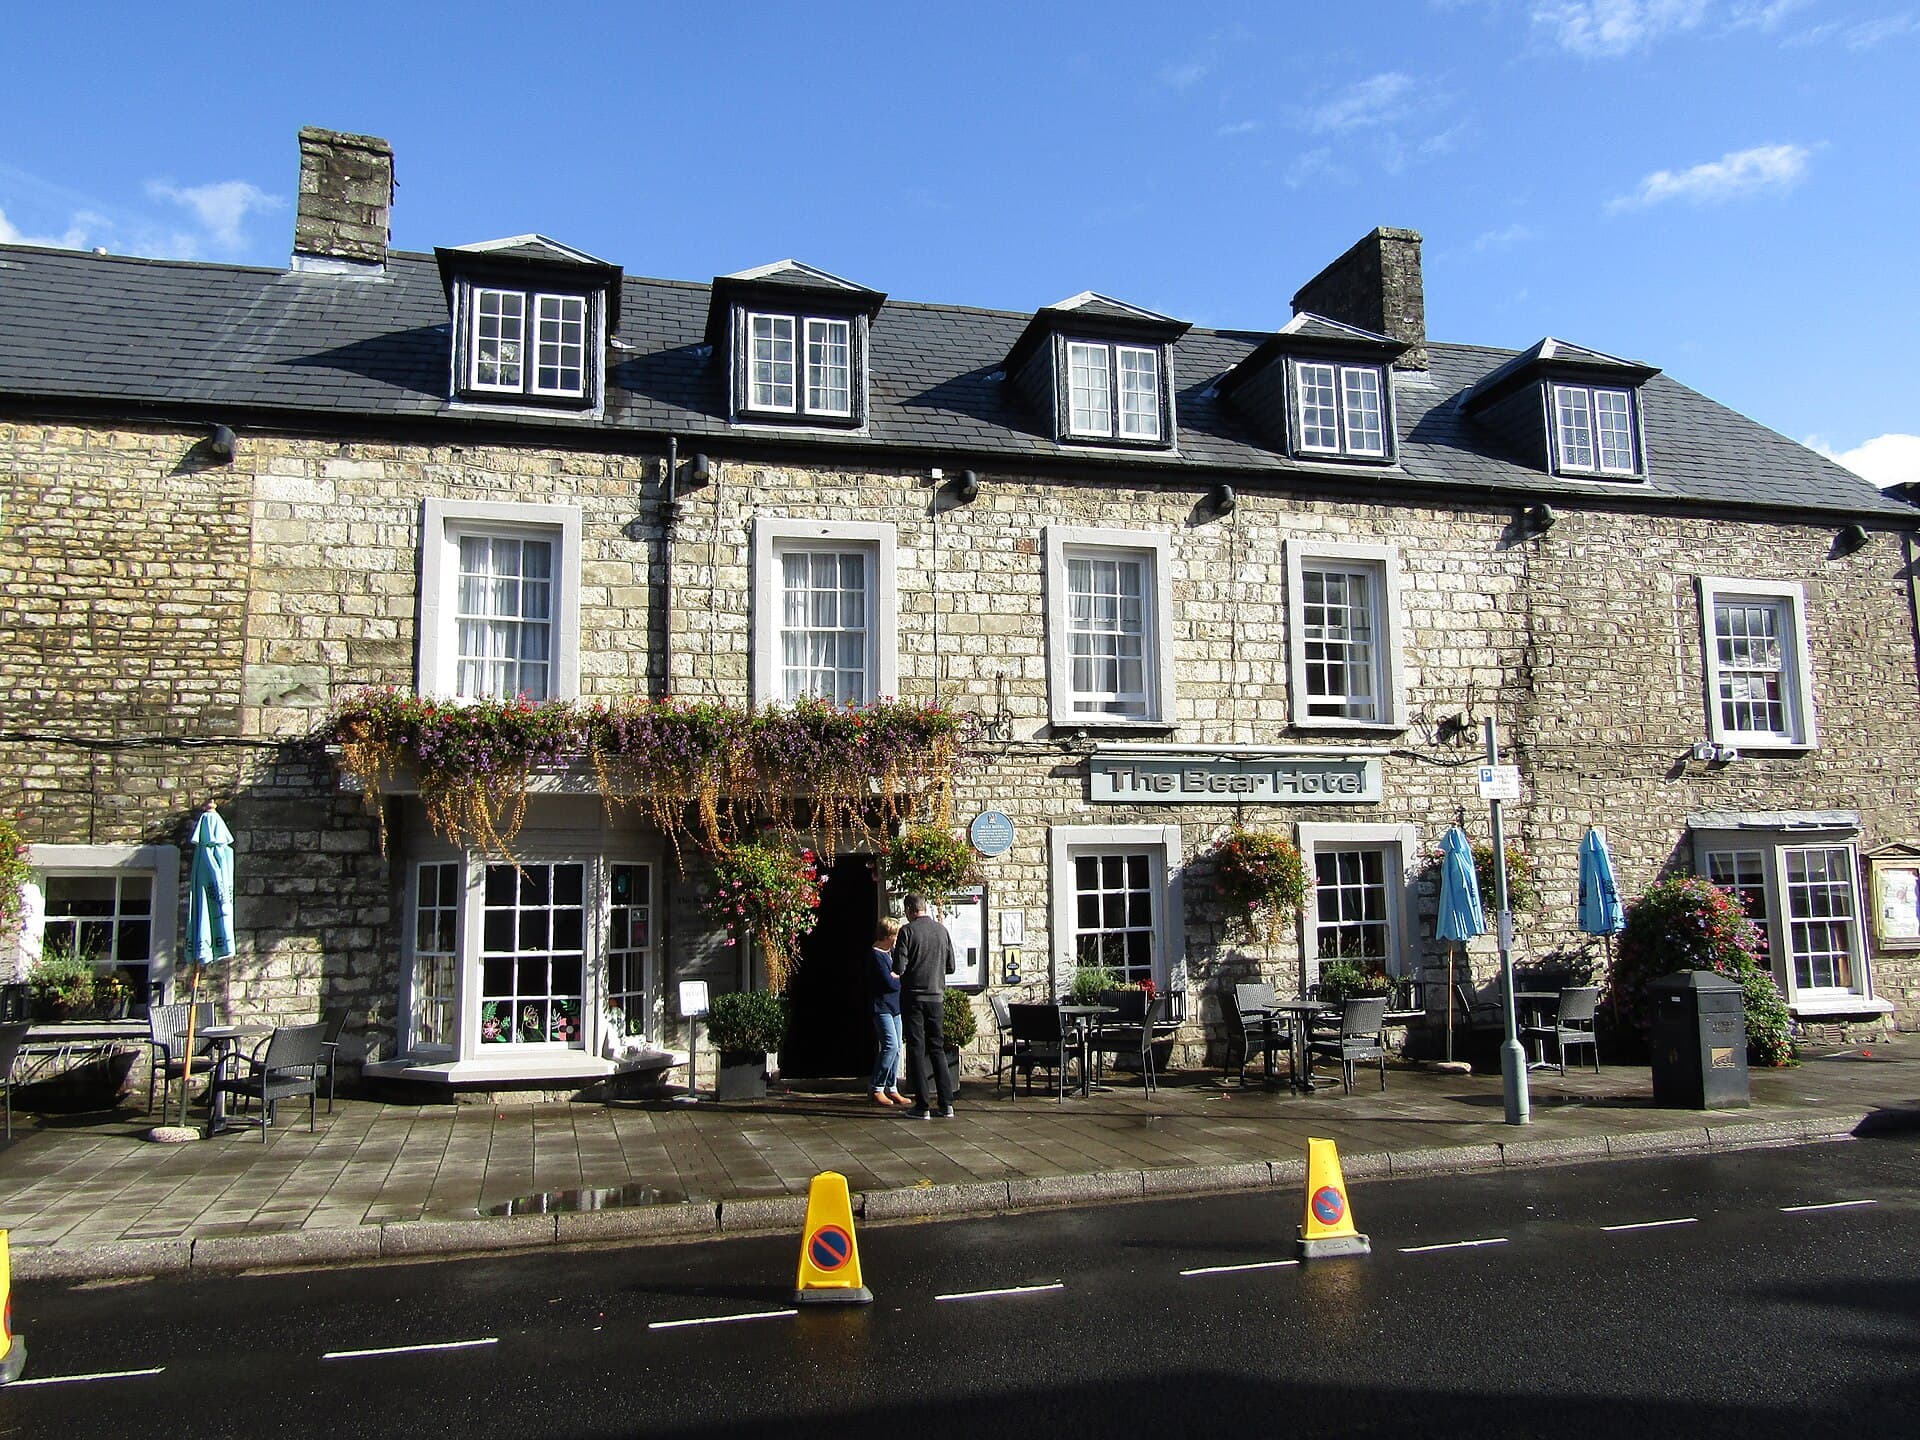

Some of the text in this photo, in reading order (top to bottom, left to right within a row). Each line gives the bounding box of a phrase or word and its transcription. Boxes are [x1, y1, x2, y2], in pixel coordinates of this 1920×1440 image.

[1106, 766, 1367, 793] The Bear Hotel
[1483, 770, 1491, 781] P
